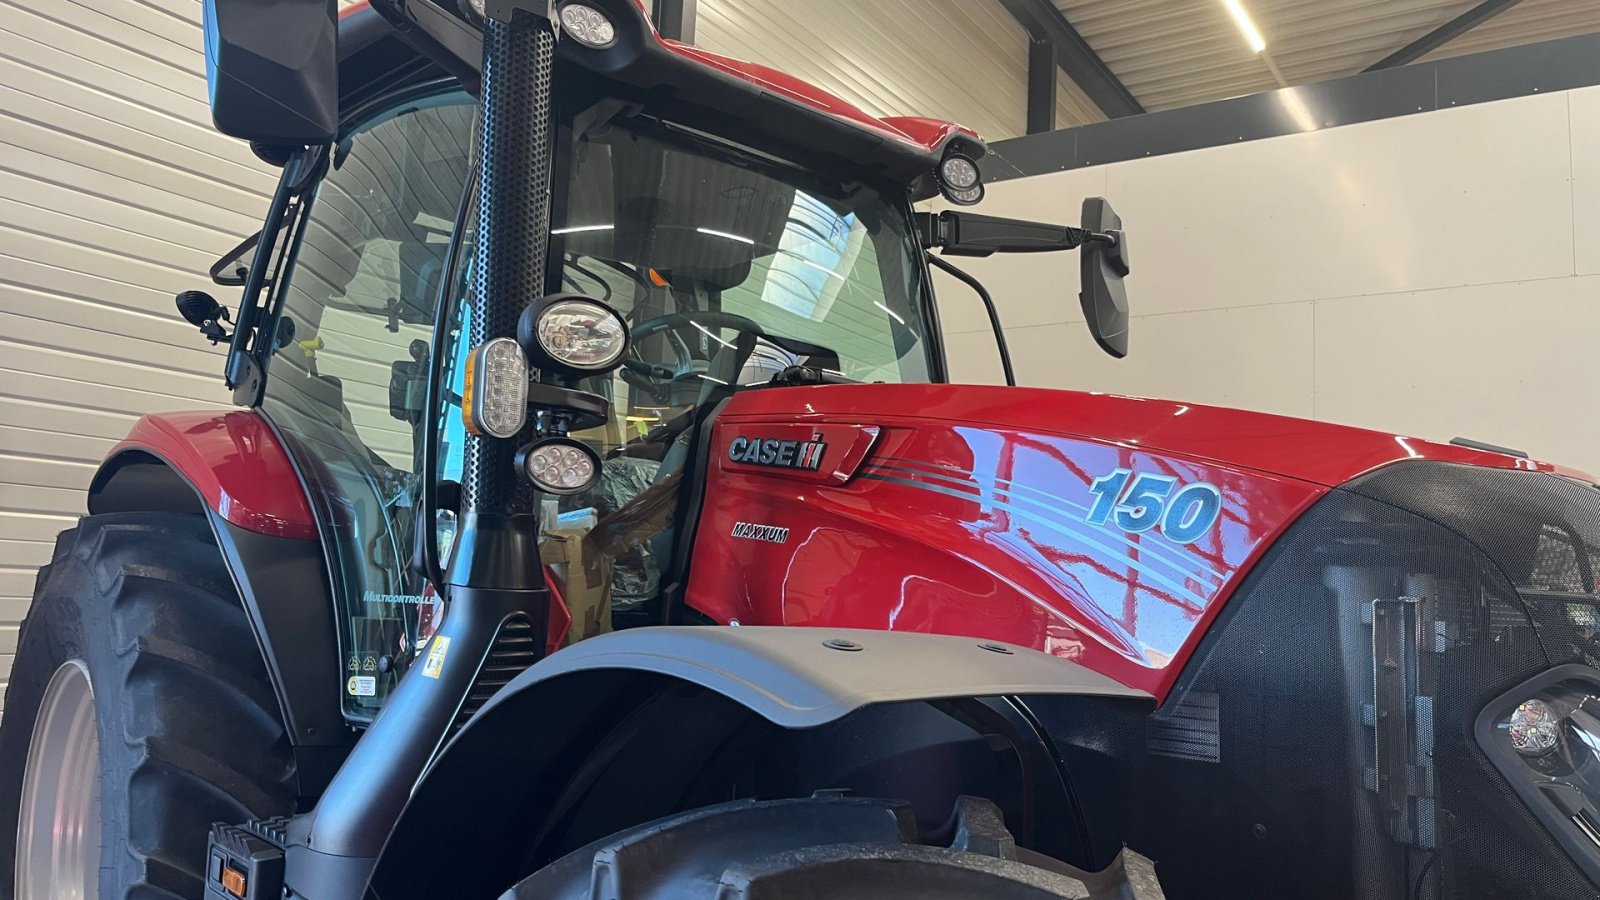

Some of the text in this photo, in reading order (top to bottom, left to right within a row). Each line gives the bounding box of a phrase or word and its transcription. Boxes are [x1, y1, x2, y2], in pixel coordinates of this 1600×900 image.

[728, 437, 797, 466] CASE
[1084, 468, 1222, 544] 150
[731, 521, 790, 544] MAXXUM
[363, 591, 439, 605] MULTICONTROLLE
